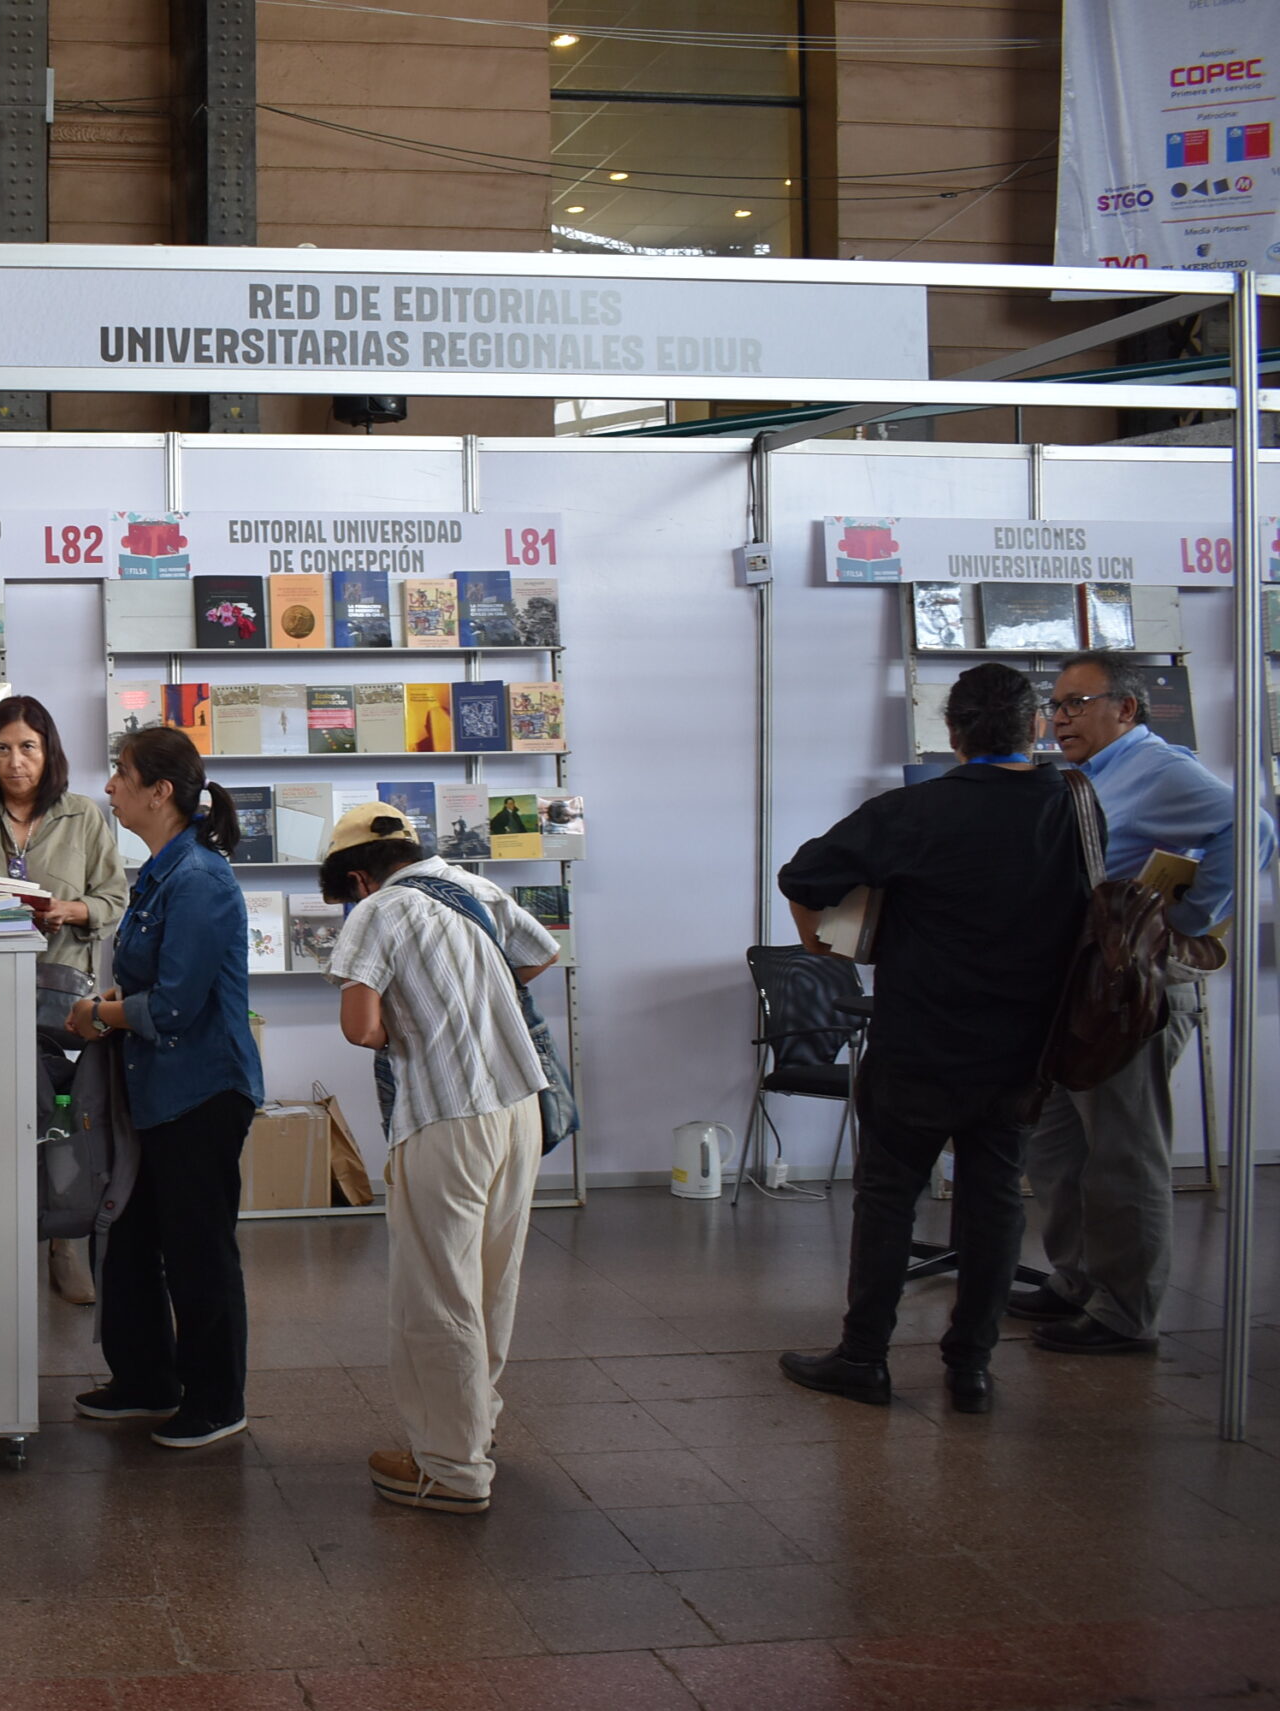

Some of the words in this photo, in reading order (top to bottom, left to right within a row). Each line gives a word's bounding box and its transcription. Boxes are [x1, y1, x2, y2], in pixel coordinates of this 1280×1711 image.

[1170, 58, 1264, 88] COPEC
[1097, 190, 1154, 212] STGO
[249, 284, 320, 320] RED
[335, 285, 381, 321] DE
[393, 286, 623, 326] EDITORIALES
[100, 326, 410, 367] UNIVERSITARIAS
[423, 331, 645, 371] REGIONALES
[656, 335, 763, 373] EDIUR
[45, 525, 103, 564] L82
[229, 520, 326, 544] EDITORIAL
[333, 520, 462, 544] UNIVERSIDAD
[505, 528, 557, 566] L81
[994, 526, 1087, 551] EDICIONES
[269, 549, 295, 573] DE
[301, 545, 424, 573] CONCEPCIÓN
[948, 554, 1093, 579] UNIVERSITARIAS
[1180, 536, 1234, 574] L80
